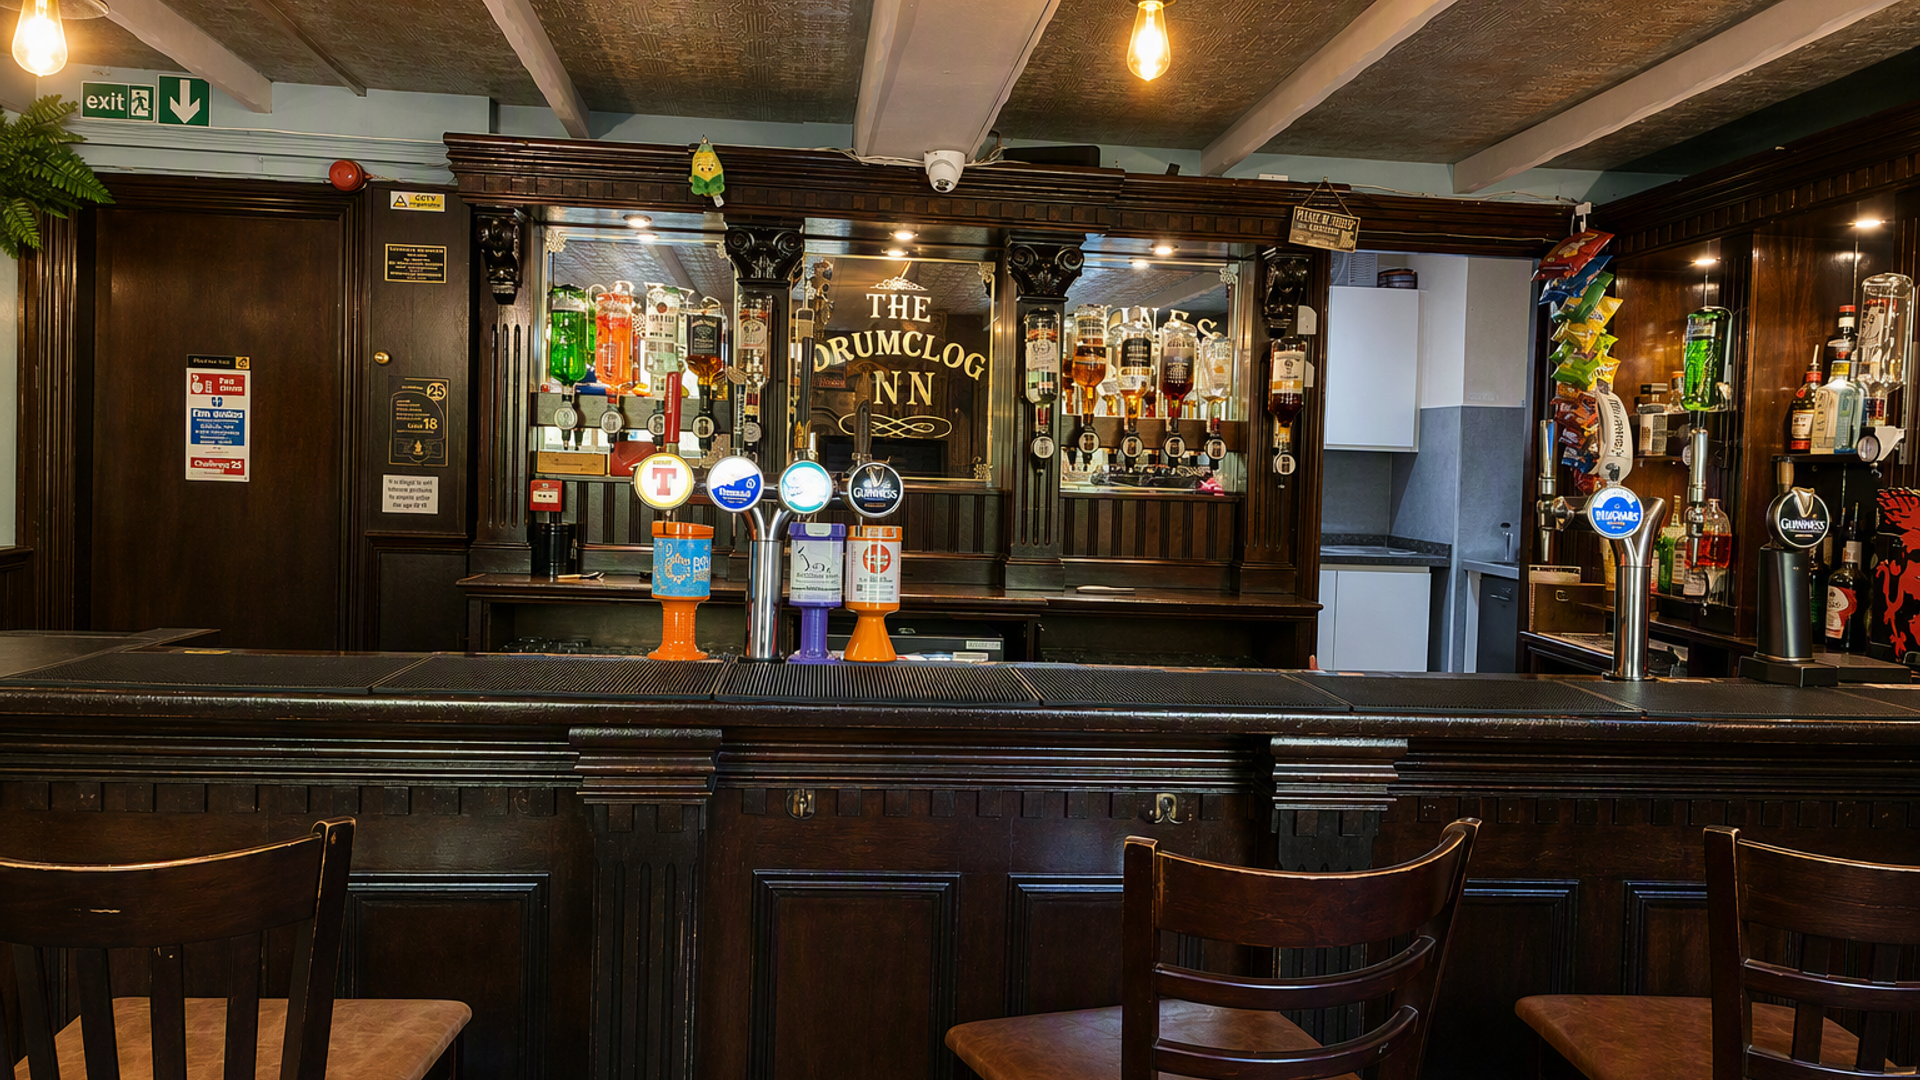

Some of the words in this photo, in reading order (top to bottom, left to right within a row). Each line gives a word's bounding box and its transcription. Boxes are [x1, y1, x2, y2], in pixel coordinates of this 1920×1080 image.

[86, 92, 125, 111] exit
[415, 194, 437, 202] CCTV
[866, 293, 932, 323] THE
[814, 330, 986, 381] DRUMCLOG
[428, 385, 445, 397] 25
[872, 370, 936, 406] NN
[423, 418, 438, 430] 18
[652, 467, 677, 496] T
[1780, 517, 1826, 530] GUINNESS
